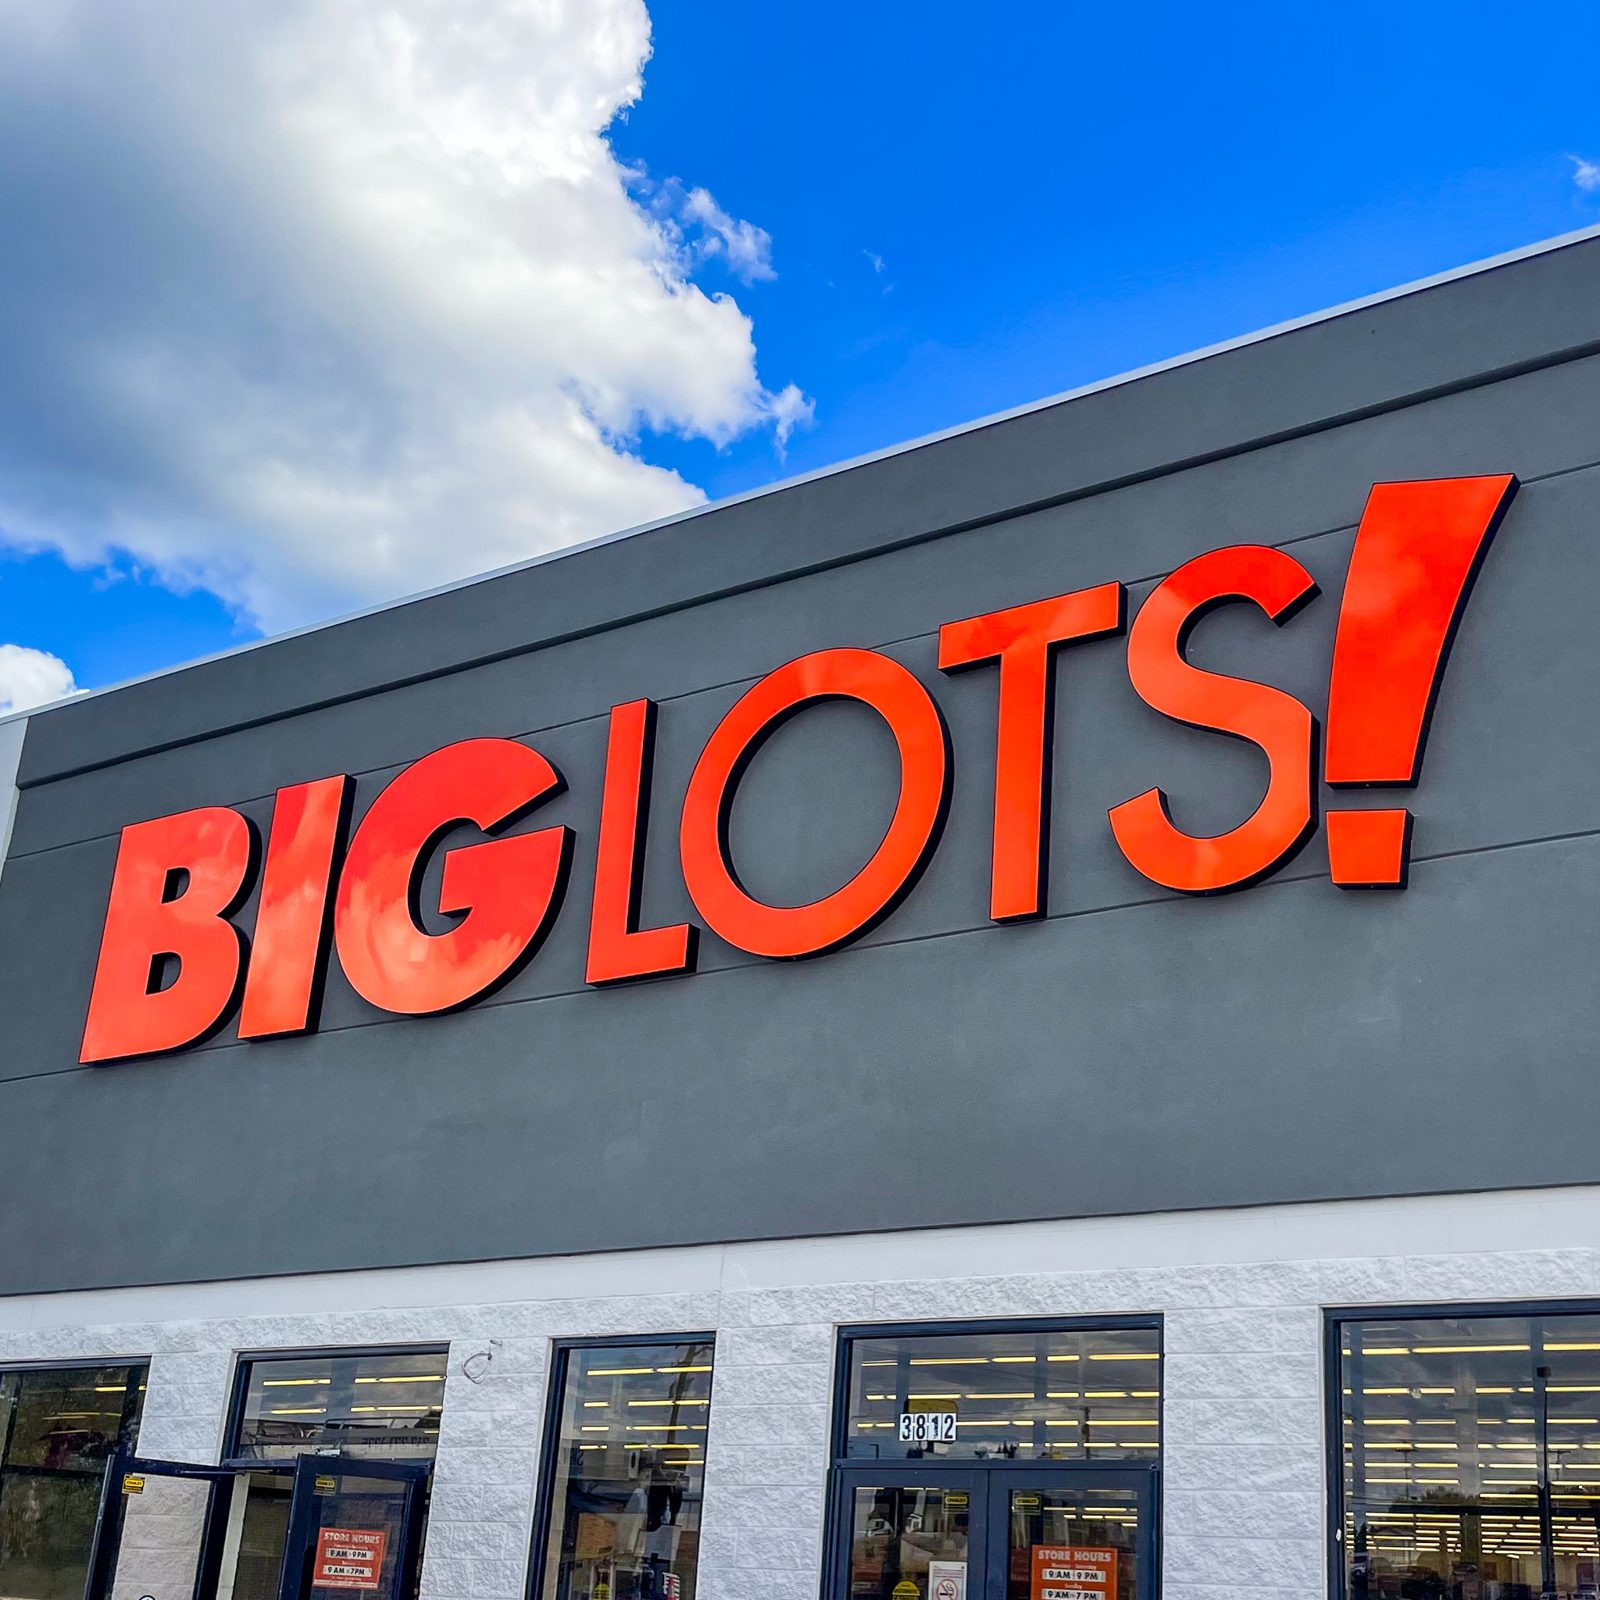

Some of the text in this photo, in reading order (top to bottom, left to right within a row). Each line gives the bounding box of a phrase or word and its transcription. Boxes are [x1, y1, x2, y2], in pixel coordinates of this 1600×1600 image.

[79, 473, 1520, 1065] BIG LOTS!
[902, 1414, 954, 1440] 3812
[324, 1532, 380, 1543] STORE HOURS
[1038, 1550, 1111, 1561] STORE HOURS
[1056, 1571, 1071, 1579] AM
[1084, 1572, 1098, 1580] PM
[1055, 1591, 1069, 1599] AM
